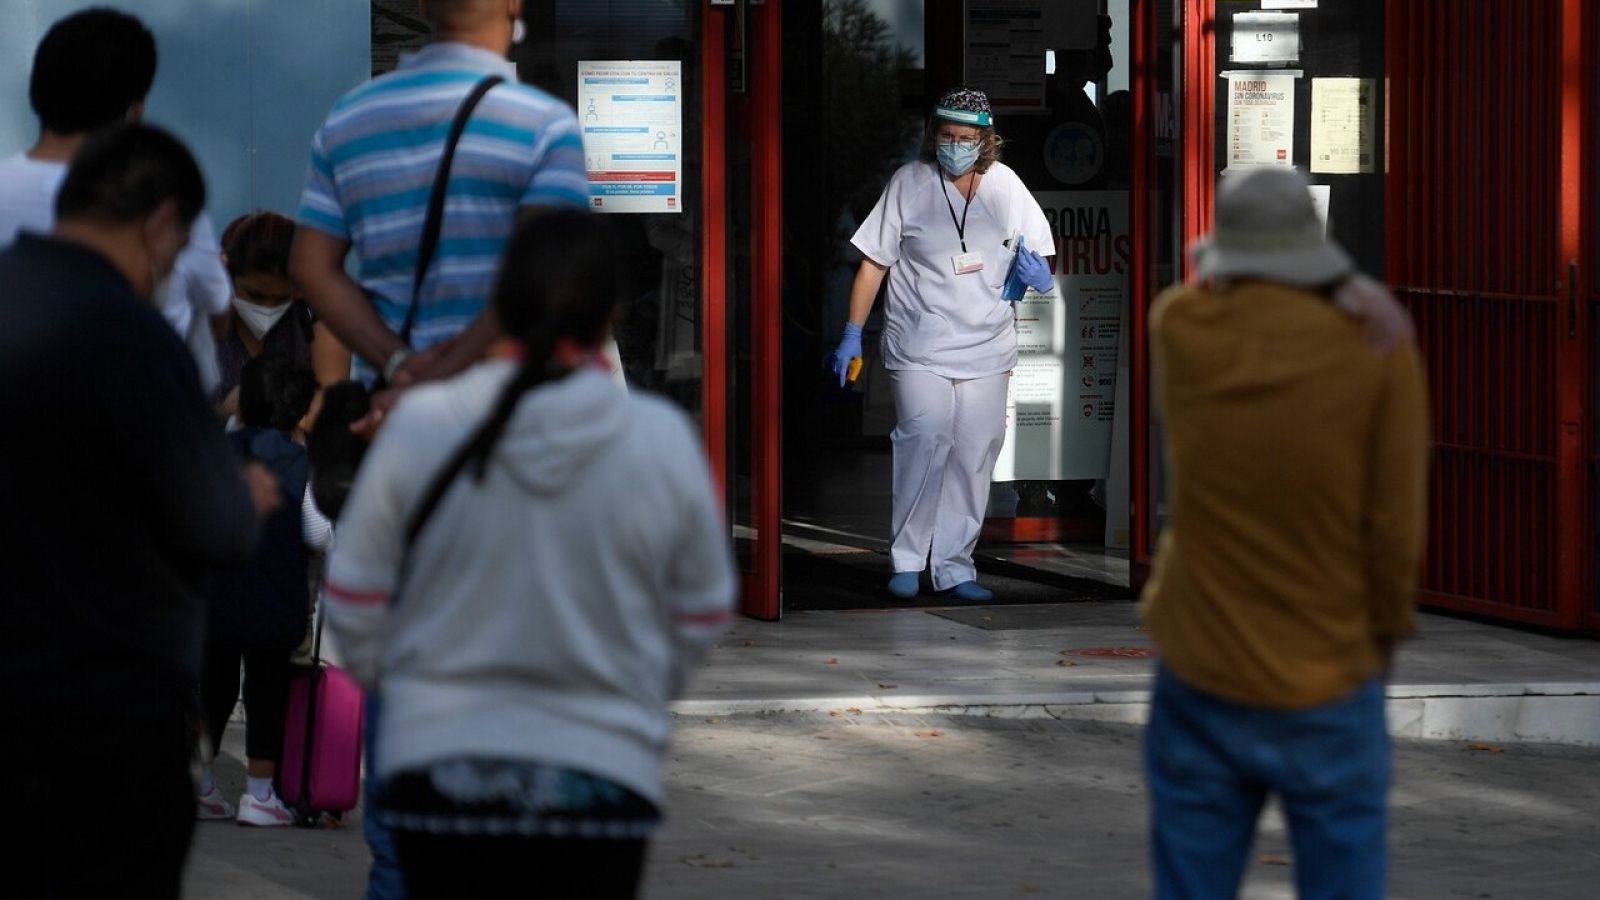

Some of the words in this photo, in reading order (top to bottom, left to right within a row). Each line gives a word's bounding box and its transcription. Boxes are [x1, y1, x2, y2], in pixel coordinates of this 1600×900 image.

[1255, 33, 1273, 42] L10
[1234, 80, 1267, 92] MADRID
[1234, 92, 1244, 100] SIN
[1245, 92, 1285, 101] CORONAVIRUS
[1043, 207, 1112, 240] RONA
